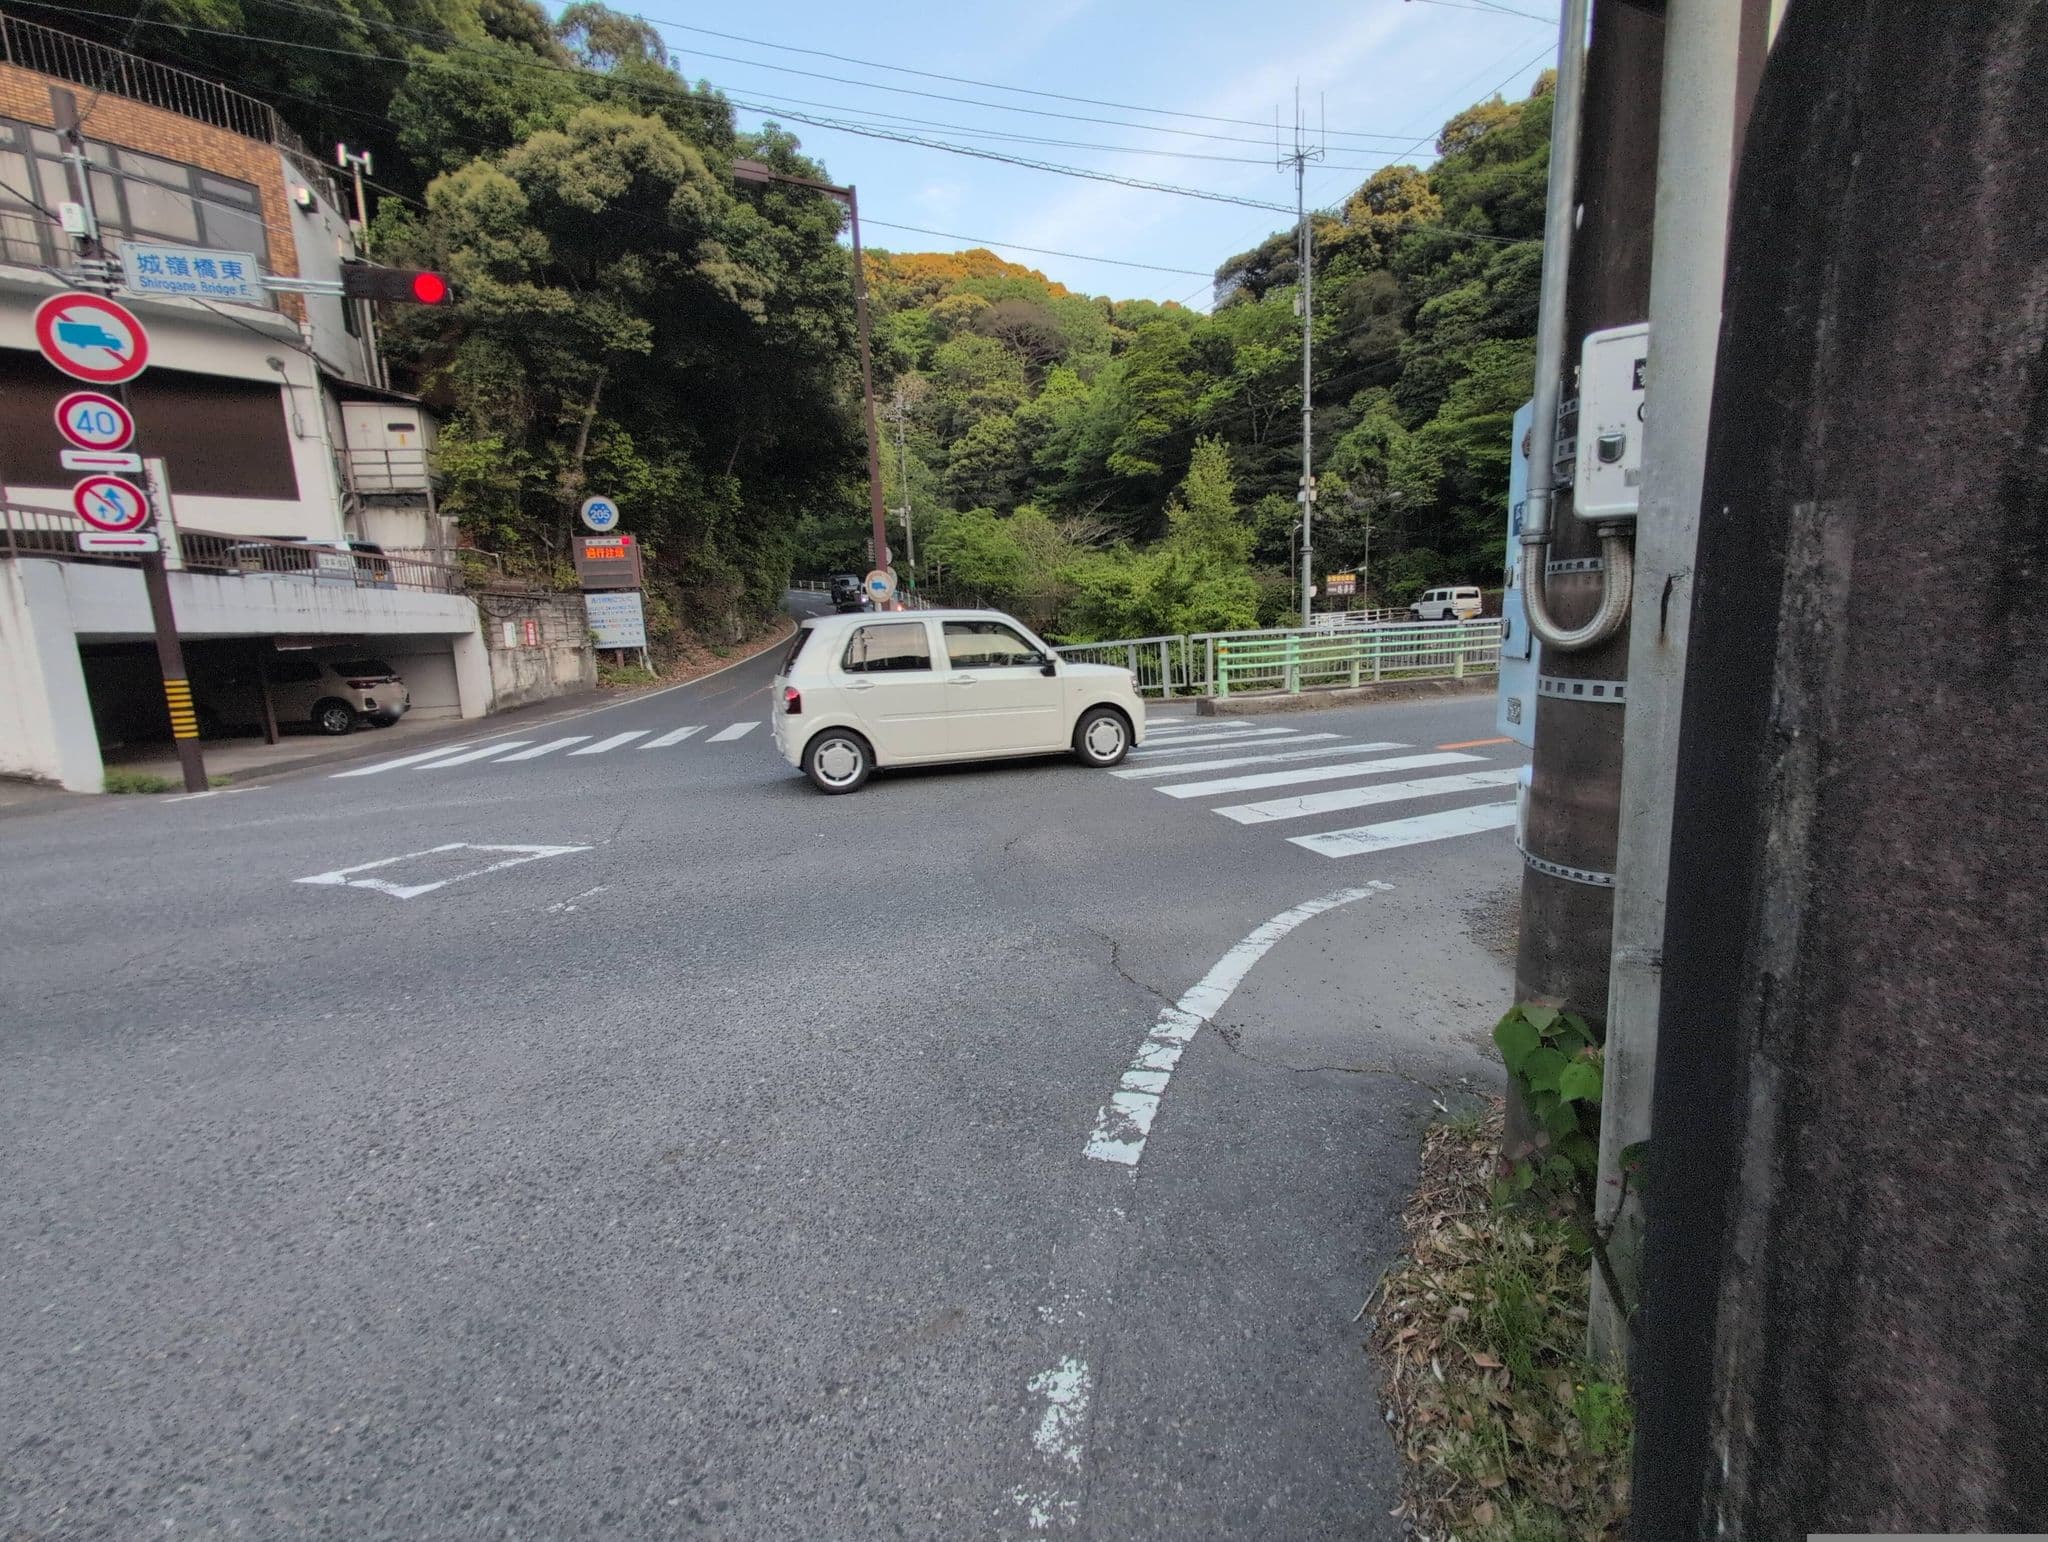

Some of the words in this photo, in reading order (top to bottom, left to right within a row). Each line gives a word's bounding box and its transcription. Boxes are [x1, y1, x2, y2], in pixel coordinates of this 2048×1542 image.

[137, 253, 245, 281] 城嶺橋東
[139, 276, 196, 293] Shirogane
[201, 281, 236, 296] Bridge
[76, 409, 116, 435] 40
[590, 509, 610, 521] 205
